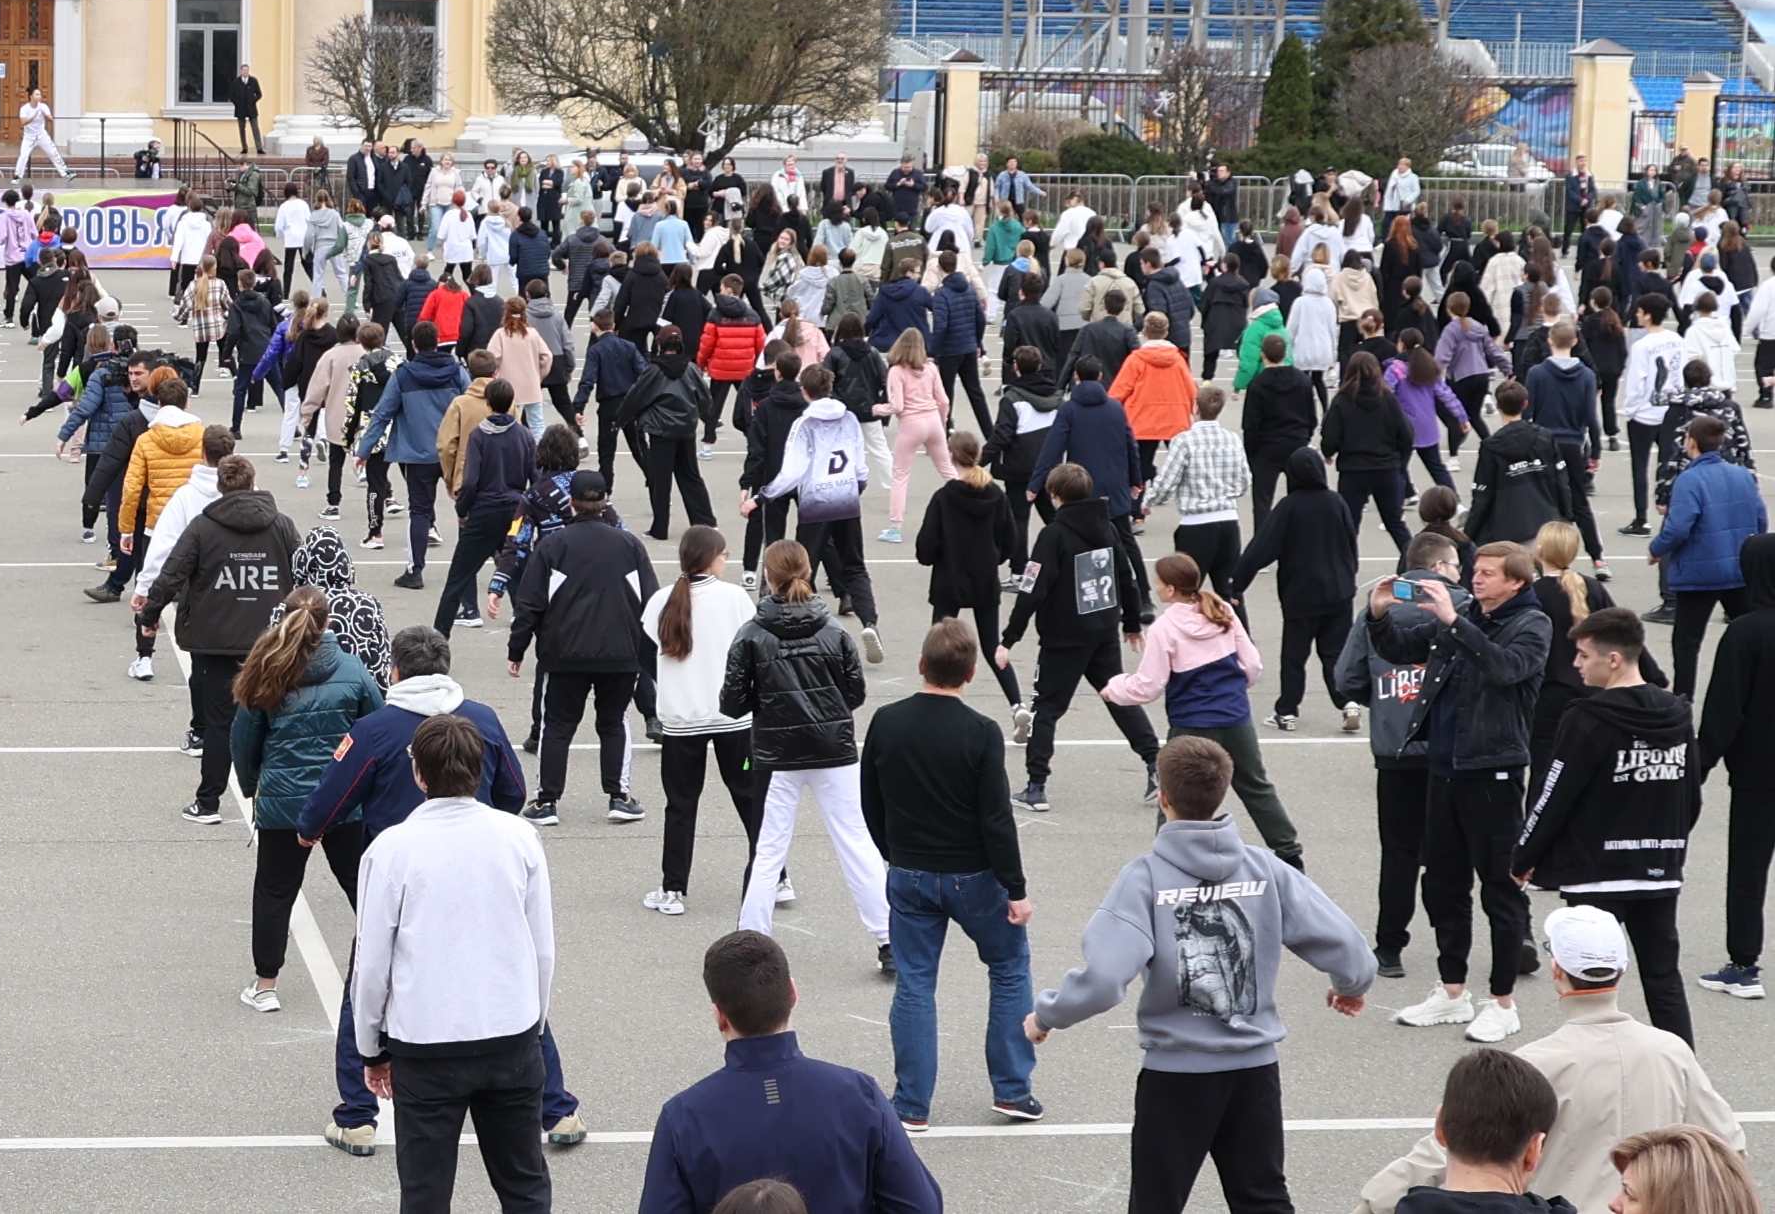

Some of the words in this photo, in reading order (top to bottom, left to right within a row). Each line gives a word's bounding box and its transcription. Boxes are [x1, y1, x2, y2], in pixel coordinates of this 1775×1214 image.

[214, 565, 280, 591] ARE
[1634, 764, 1679, 782] GYM
[1157, 880, 1267, 906] REVIEW
